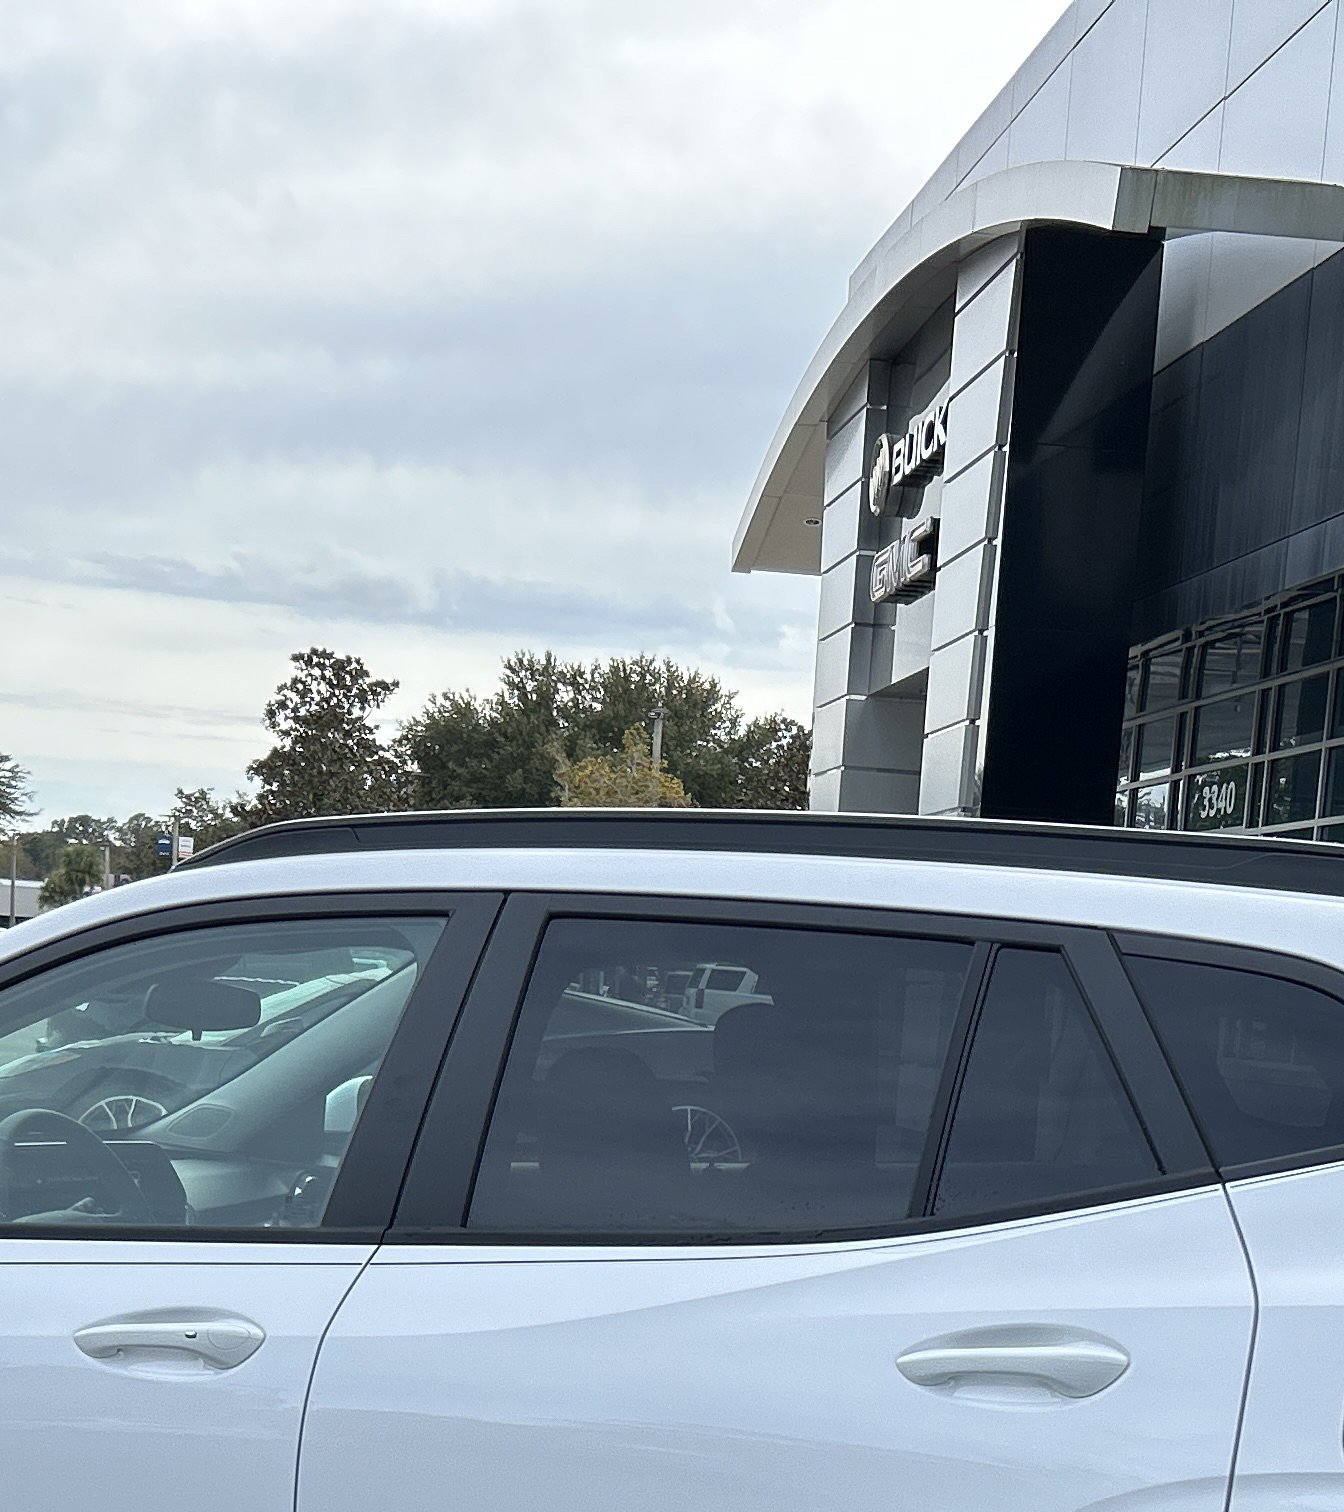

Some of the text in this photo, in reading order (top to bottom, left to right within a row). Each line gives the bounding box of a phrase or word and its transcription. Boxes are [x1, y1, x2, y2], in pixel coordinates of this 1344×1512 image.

[891, 398, 950, 486] BUICK
[870, 516, 933, 602] GMC
[1200, 781, 1236, 819] 3340
